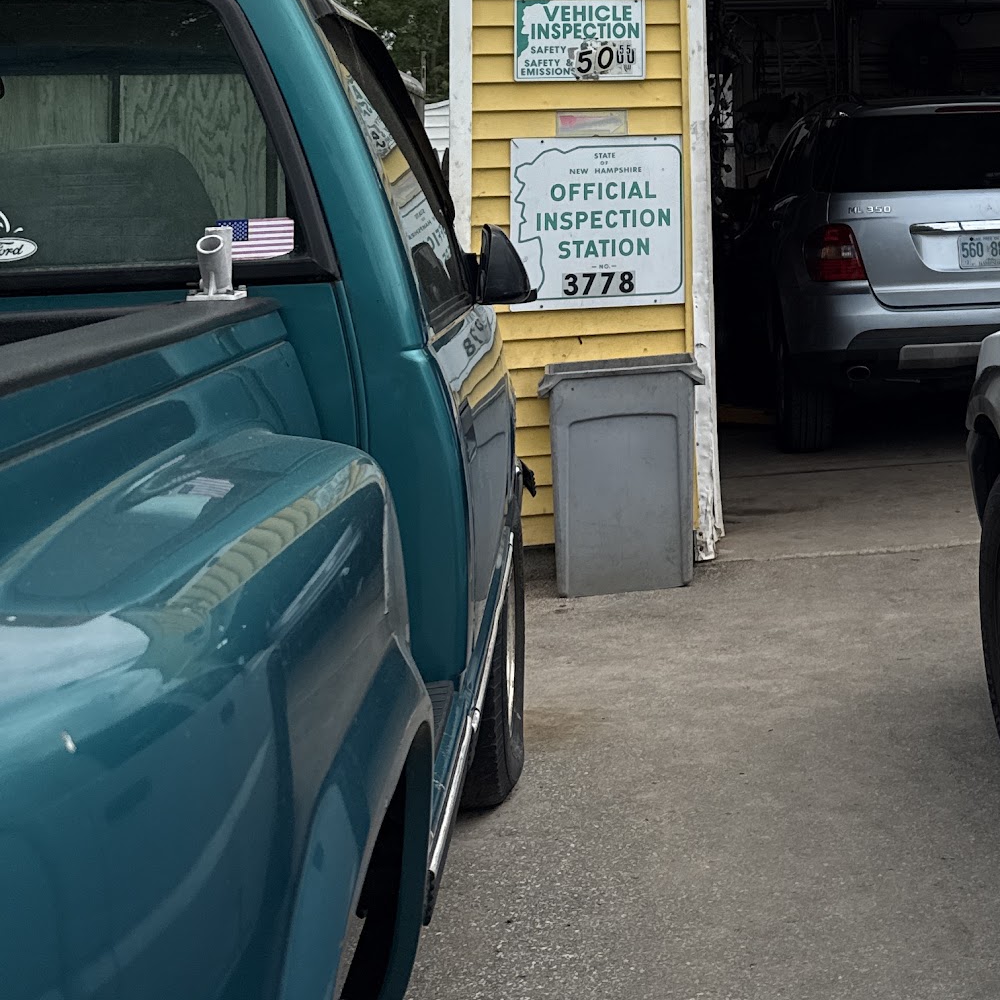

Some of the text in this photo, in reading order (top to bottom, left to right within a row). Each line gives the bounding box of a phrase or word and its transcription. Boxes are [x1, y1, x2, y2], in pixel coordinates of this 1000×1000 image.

[543, 5, 632, 21] VEHICLE
[531, 22, 640, 39] INSPECTION
[530, 46, 566, 54] SAFETY
[524, 58, 560, 67] SAFETY
[521, 67, 576, 76] EMISSIONS
[594, 166, 642, 174] HAMPSHIRE
[550, 181, 656, 202] OFFICIAL
[848, 205, 892, 214] ML 350
[536, 208, 671, 231] INSPECTION
[558, 237, 650, 259] STATION
[961, 241, 984, 258] 560
[563, 271, 635, 296] 3778
